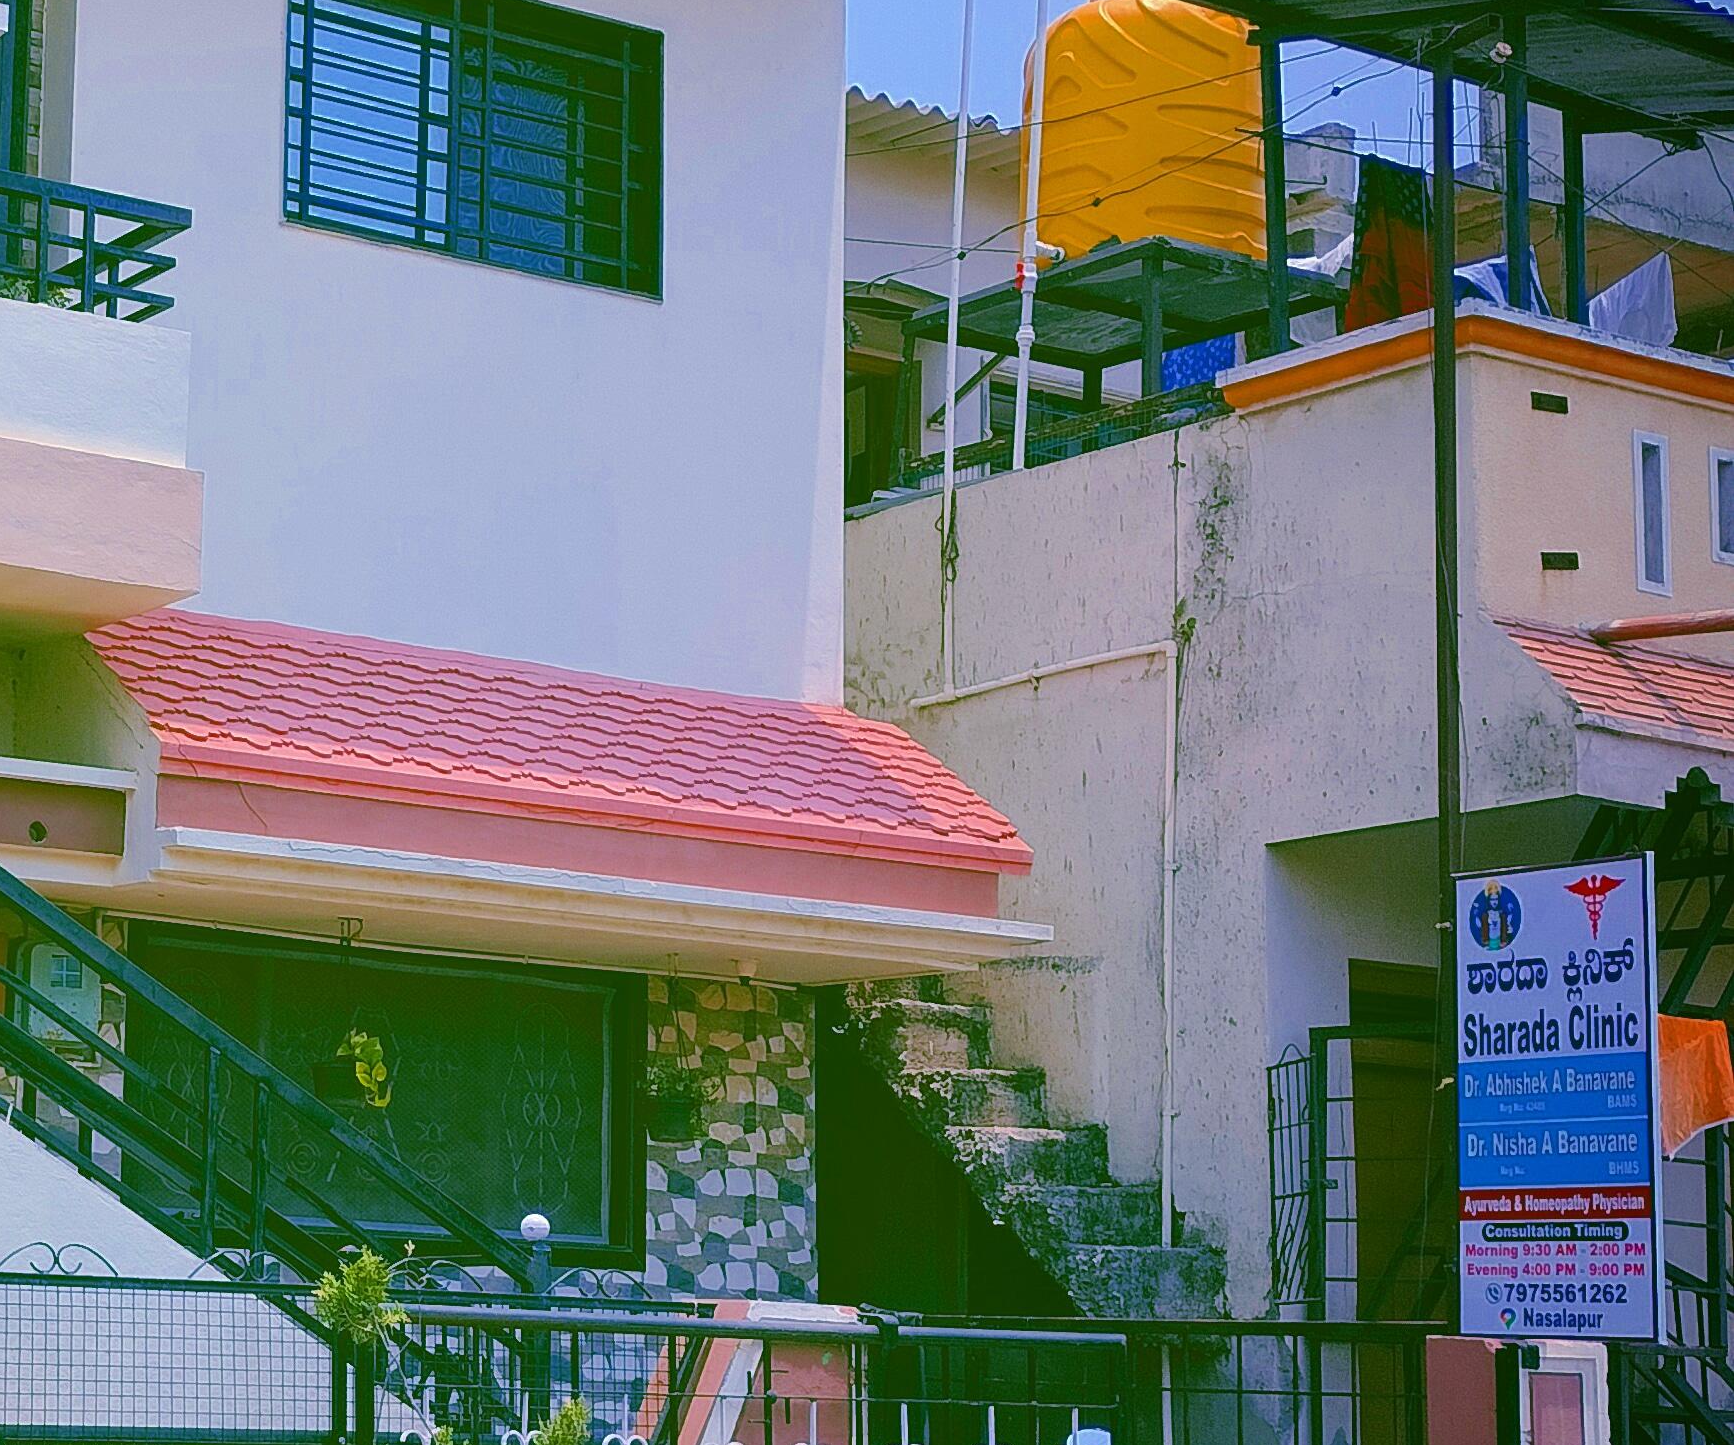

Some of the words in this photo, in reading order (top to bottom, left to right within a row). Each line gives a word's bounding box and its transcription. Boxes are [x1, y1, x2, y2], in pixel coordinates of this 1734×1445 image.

[1467, 948, 1548, 995] ಶಾರದಾ
[1562, 938, 1634, 1003] ಕ್ಲಿನಿಕ್
[1464, 1008, 1560, 1057] Sharada
[1569, 1002, 1638, 1050] Clinic
[1465, 1074, 1482, 1098] Dr.
[1486, 1070, 1549, 1097] Abhishek
[1552, 1068, 1563, 1093] A
[1566, 1068, 1635, 1092] Banavane
[1607, 1094, 1638, 1109] BAMS
[1467, 1133, 1488, 1157] Dr.
[1493, 1132, 1537, 1156] Nisha
[1542, 1130, 1553, 1155] A
[1558, 1130, 1638, 1155] Banavane
[1608, 1161, 1640, 1176] BHMS
[1464, 1195, 1512, 1217] Ayurveda
[1513, 1194, 1523, 1212] &
[1524, 1193, 1591, 1215] Homeopathy
[1592, 1193, 1645, 1215] Physician
[1485, 1224, 1571, 1238] Consultation
[1573, 1223, 1623, 1239] Timing
[1466, 1243, 1519, 1259] Morning
[1522, 1243, 1551, 1256] 9:30
[1555, 1243, 1577, 1256] AM
[1590, 1243, 1620, 1256] 2:00
[1624, 1243, 1646, 1256] PM
[1467, 1263, 1519, 1279] Evening
[1522, 1263, 1551, 1276] 4:00
[1555, 1263, 1577, 1276] PM
[1589, 1263, 1619, 1276] 9:00
[1623, 1263, 1645, 1276] PM
[1503, 1283, 1628, 1304] 7975561262
[1523, 1307, 1604, 1333] Nasalapur
